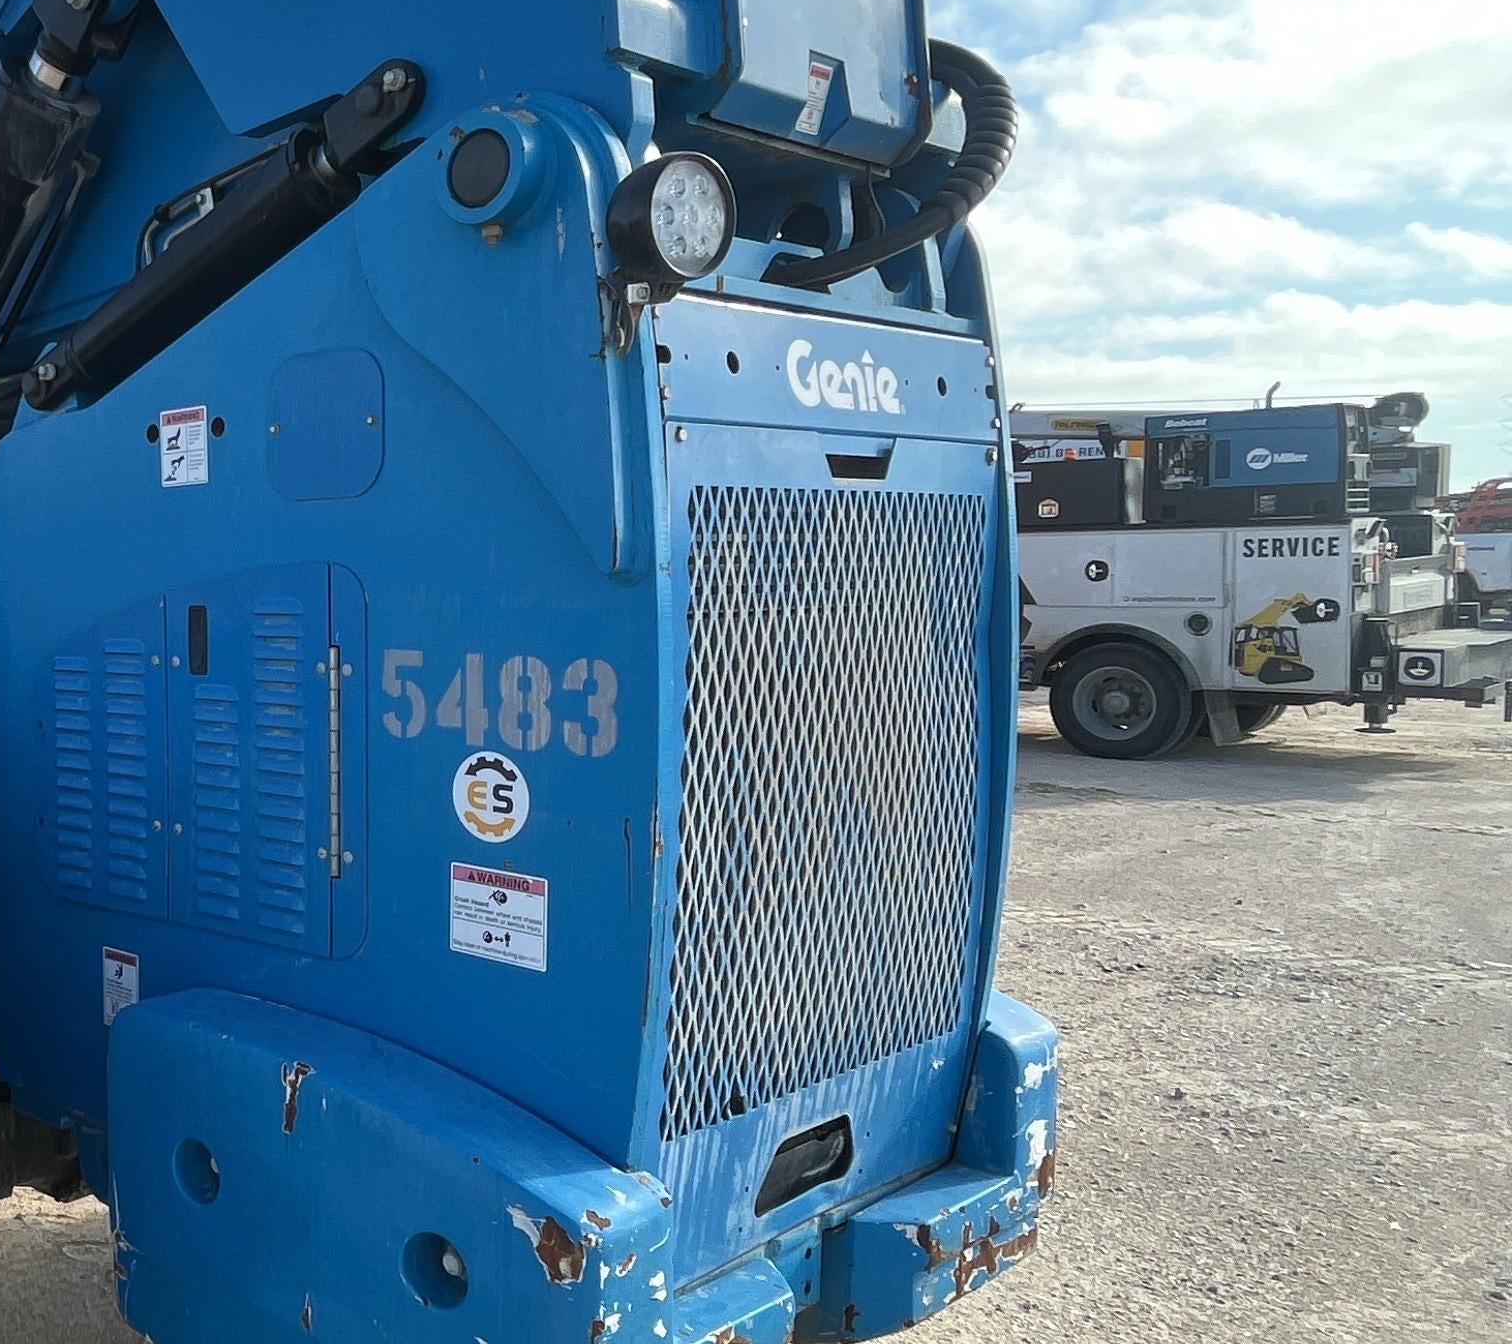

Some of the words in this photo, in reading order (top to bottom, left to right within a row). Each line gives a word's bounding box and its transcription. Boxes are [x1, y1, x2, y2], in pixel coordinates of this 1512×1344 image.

[787, 339, 900, 414] Genie
[1164, 418, 1208, 429] Bobcat
[1273, 452, 1309, 464] Miller
[1242, 536, 1340, 558] SERVICE
[382, 649, 618, 757] 5483
[467, 780, 514, 814] ES
[478, 872, 530, 891] WARNING
